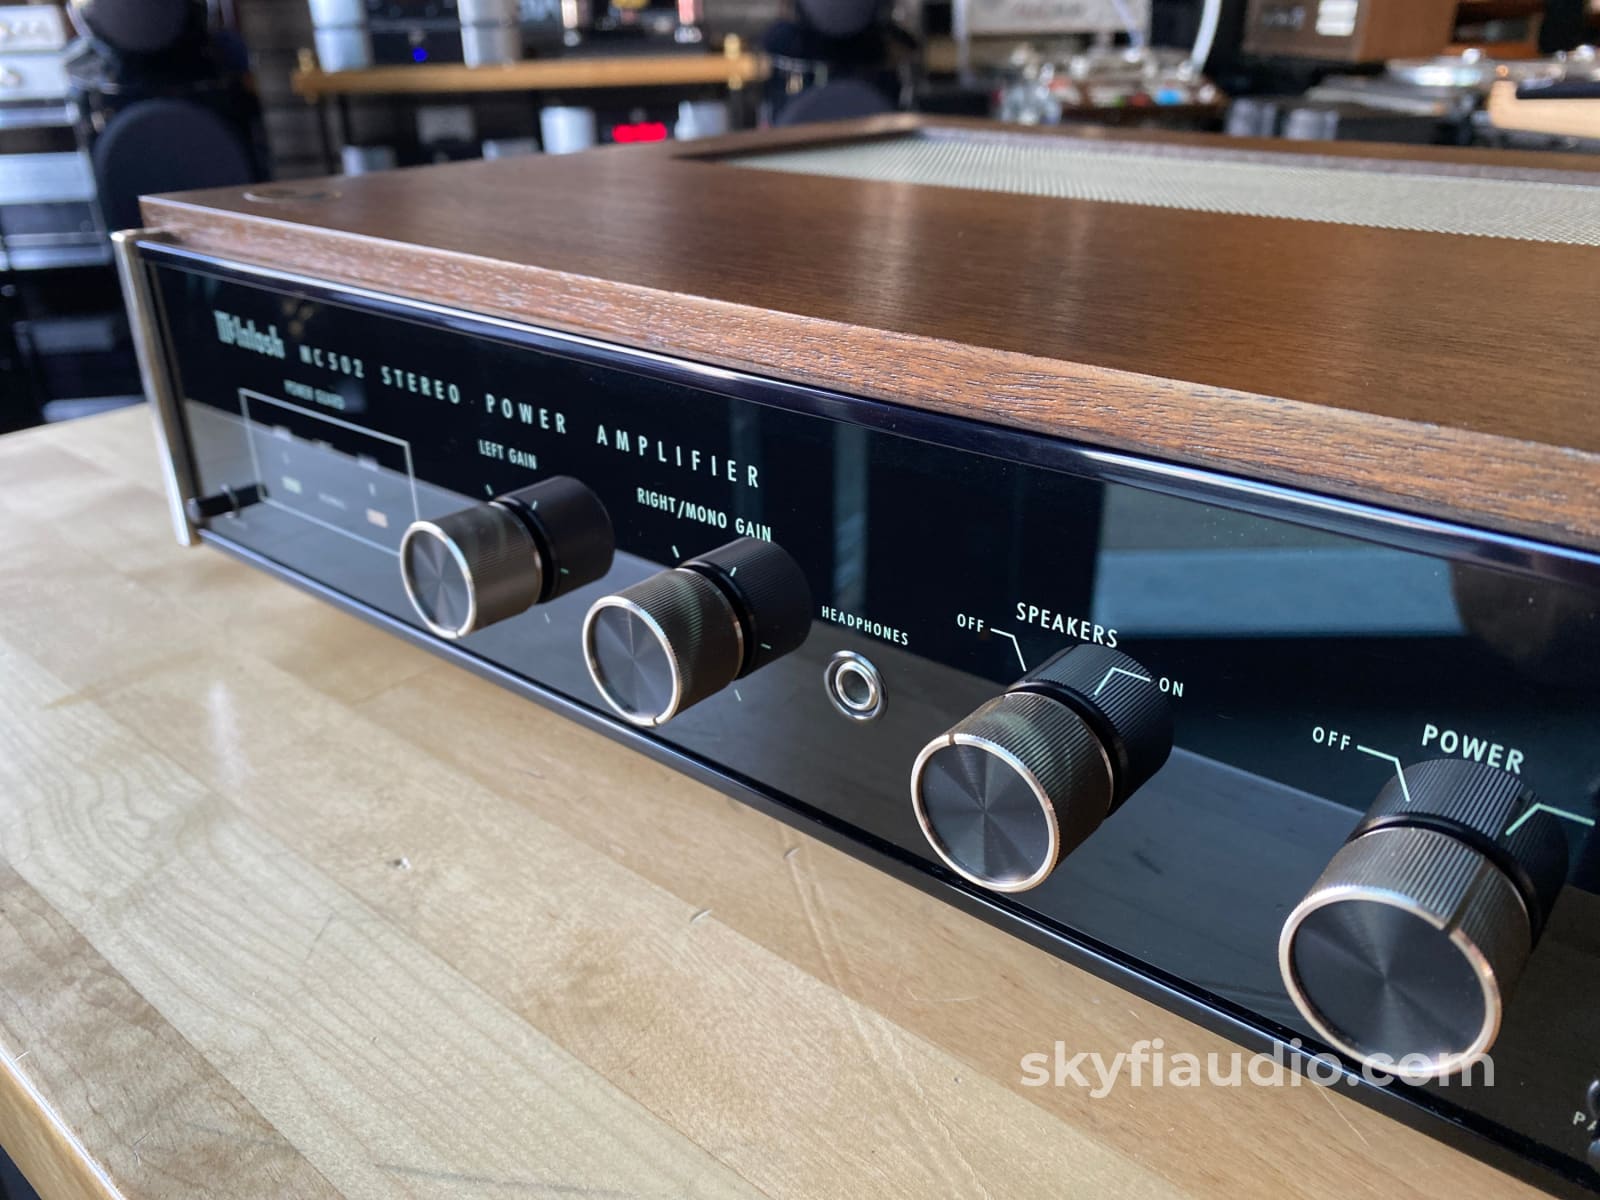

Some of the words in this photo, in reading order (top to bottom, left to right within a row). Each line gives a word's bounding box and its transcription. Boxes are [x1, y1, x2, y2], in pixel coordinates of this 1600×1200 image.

[381, 366, 460, 403] STEREO
[485, 393, 566, 434] POWER
[596, 424, 759, 488] AMPLIFIER
[478, 439, 504, 460] LEFT
[508, 448, 537, 470] GAIN
[637, 487, 727, 528] RIGHT/MONO
[735, 517, 772, 542] GAIN
[821, 605, 909, 646] HEADPHONES
[956, 613, 985, 632] OFF
[1016, 602, 1118, 648] SPEAKERS
[1158, 677, 1184, 697] ON
[1312, 726, 1351, 751] OFF
[1421, 723, 1525, 775] POWER
